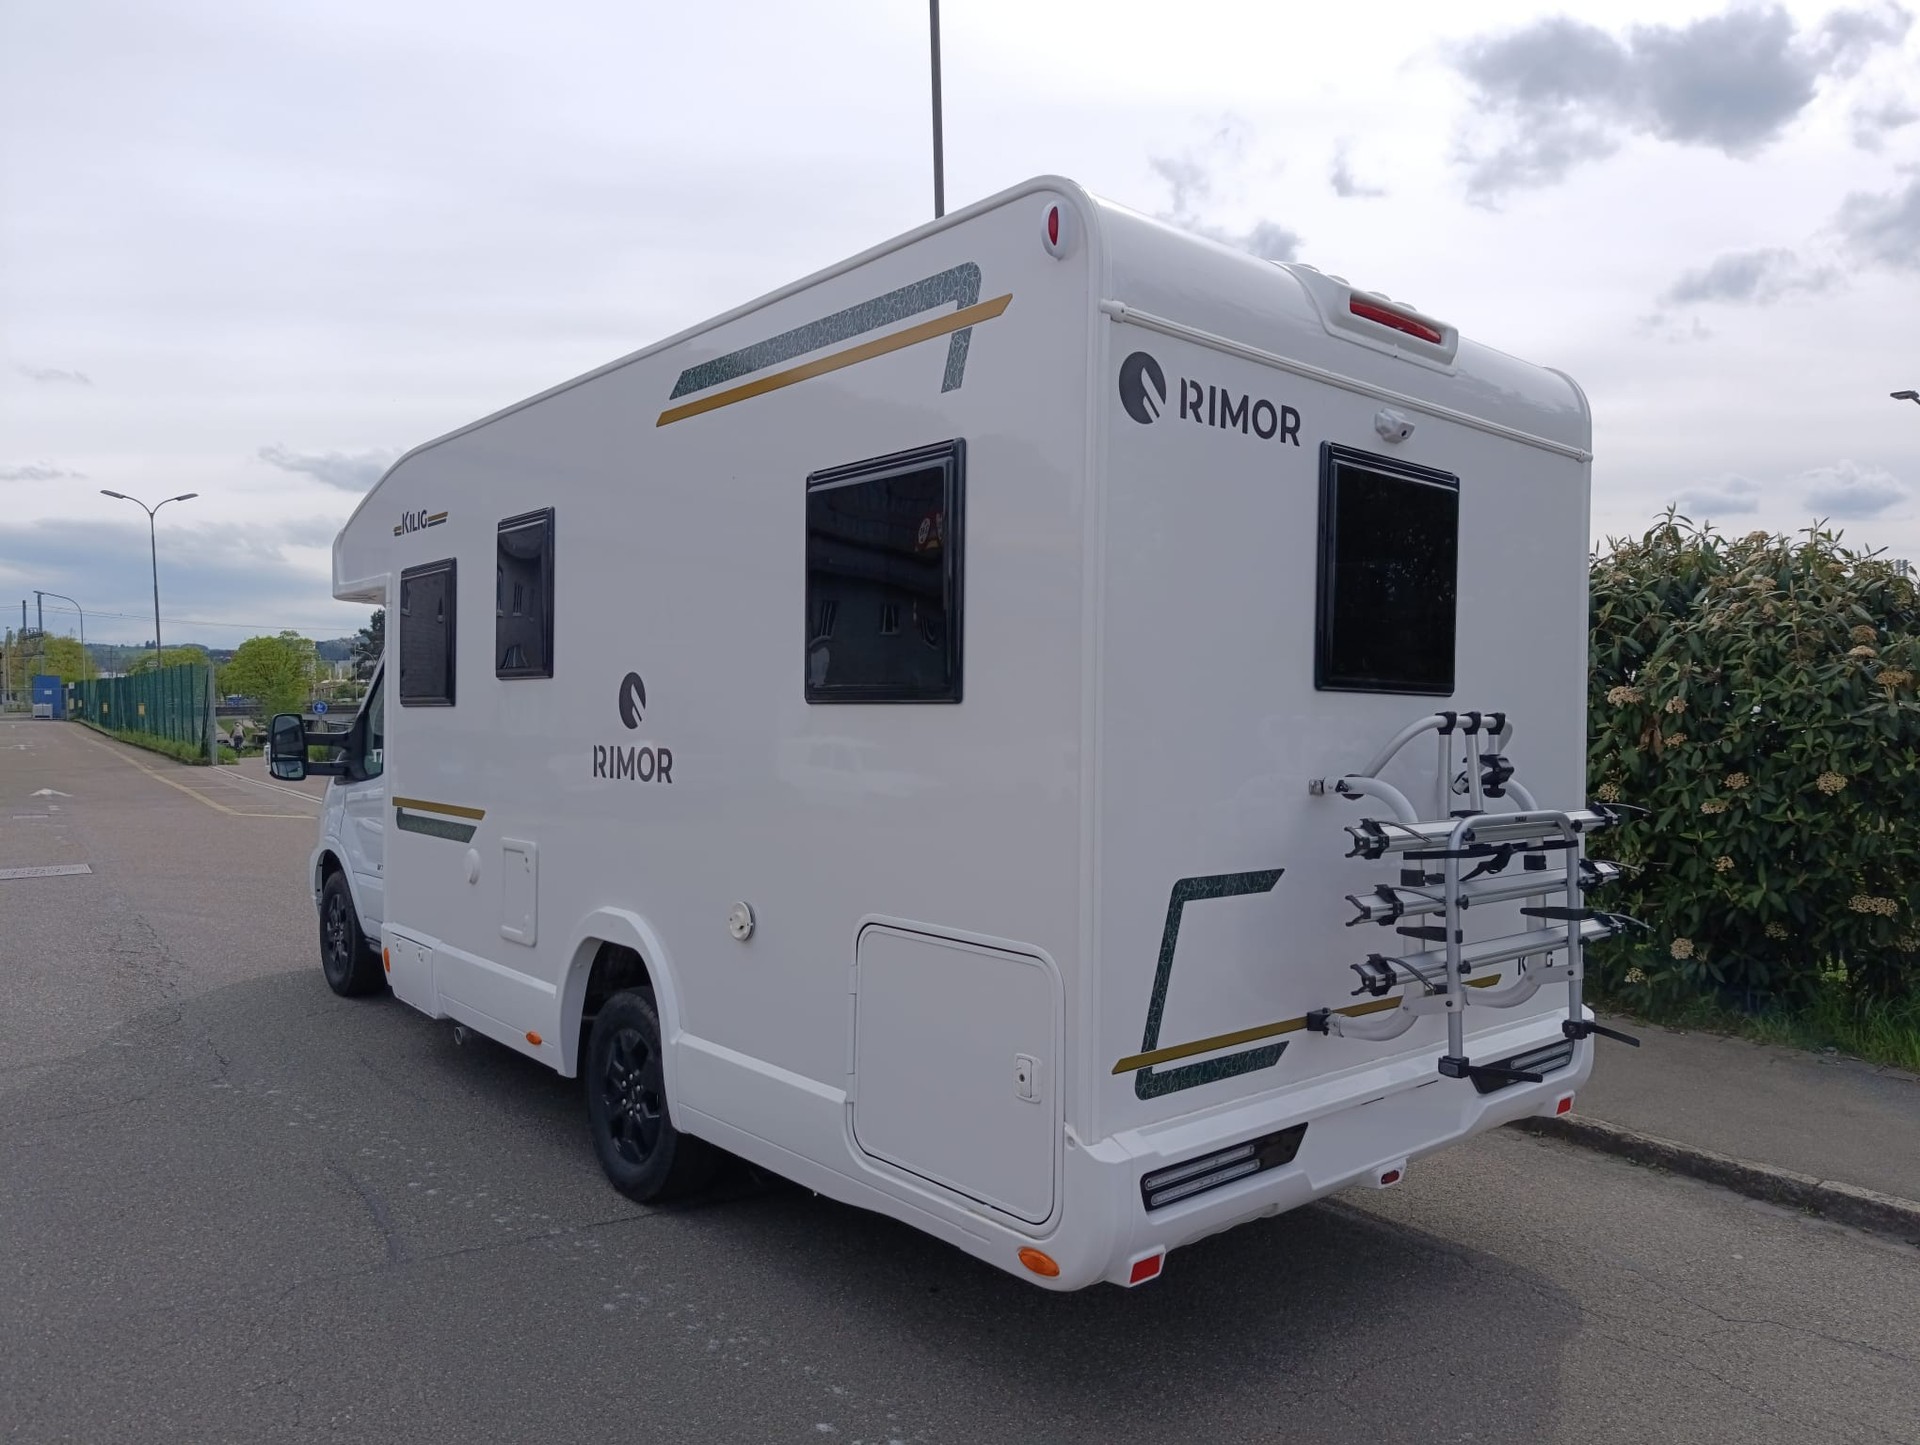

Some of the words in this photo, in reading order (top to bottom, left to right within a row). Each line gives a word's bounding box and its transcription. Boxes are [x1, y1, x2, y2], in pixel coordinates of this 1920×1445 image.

[1180, 377, 1301, 447] RIMOR
[402, 509, 428, 535] KILIG
[593, 744, 673, 784] RIMOR
